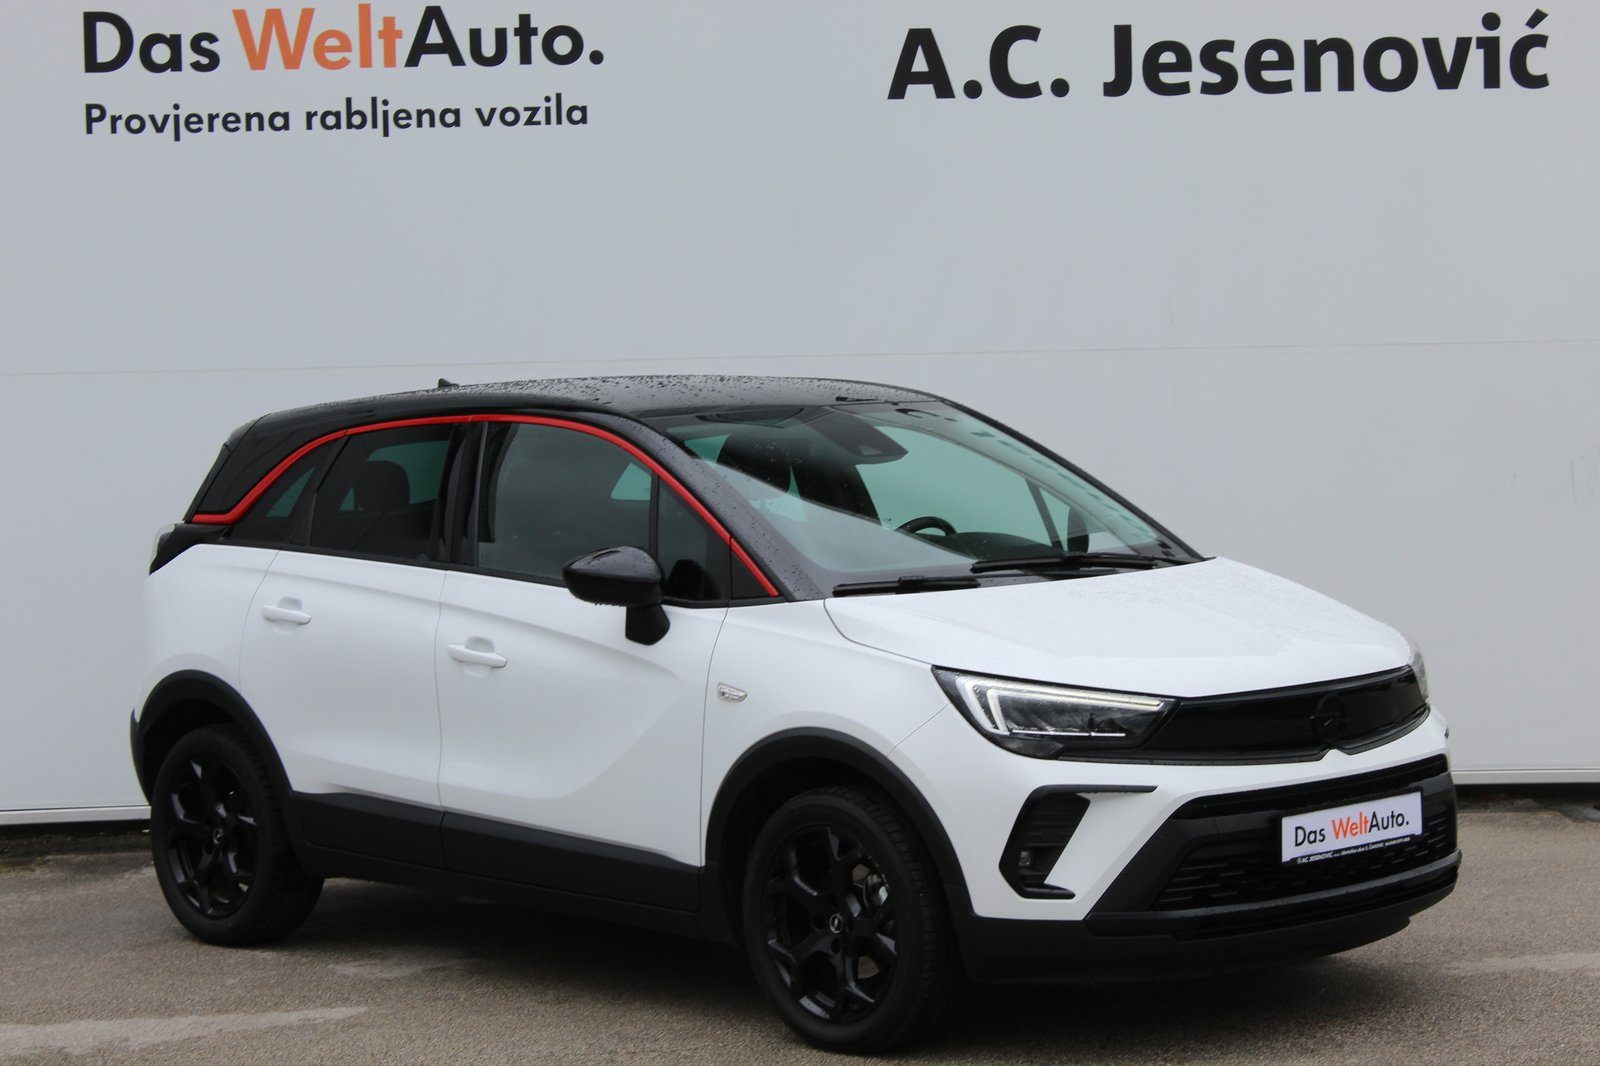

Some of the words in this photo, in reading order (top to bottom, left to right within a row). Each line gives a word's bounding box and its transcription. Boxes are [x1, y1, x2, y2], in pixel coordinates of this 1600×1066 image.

[83, 10, 220, 74] Das
[232, 3, 605, 71] WeltAuto.
[886, 24, 1071, 101] A.C.
[1102, 8, 1550, 98] Jesenović
[85, 102, 290, 142] Provjerena
[305, 96, 461, 138] rabljena
[474, 92, 588, 128] vozila
[1294, 825, 1326, 848] Das
[1331, 809, 1410, 840] WeltAuto.
